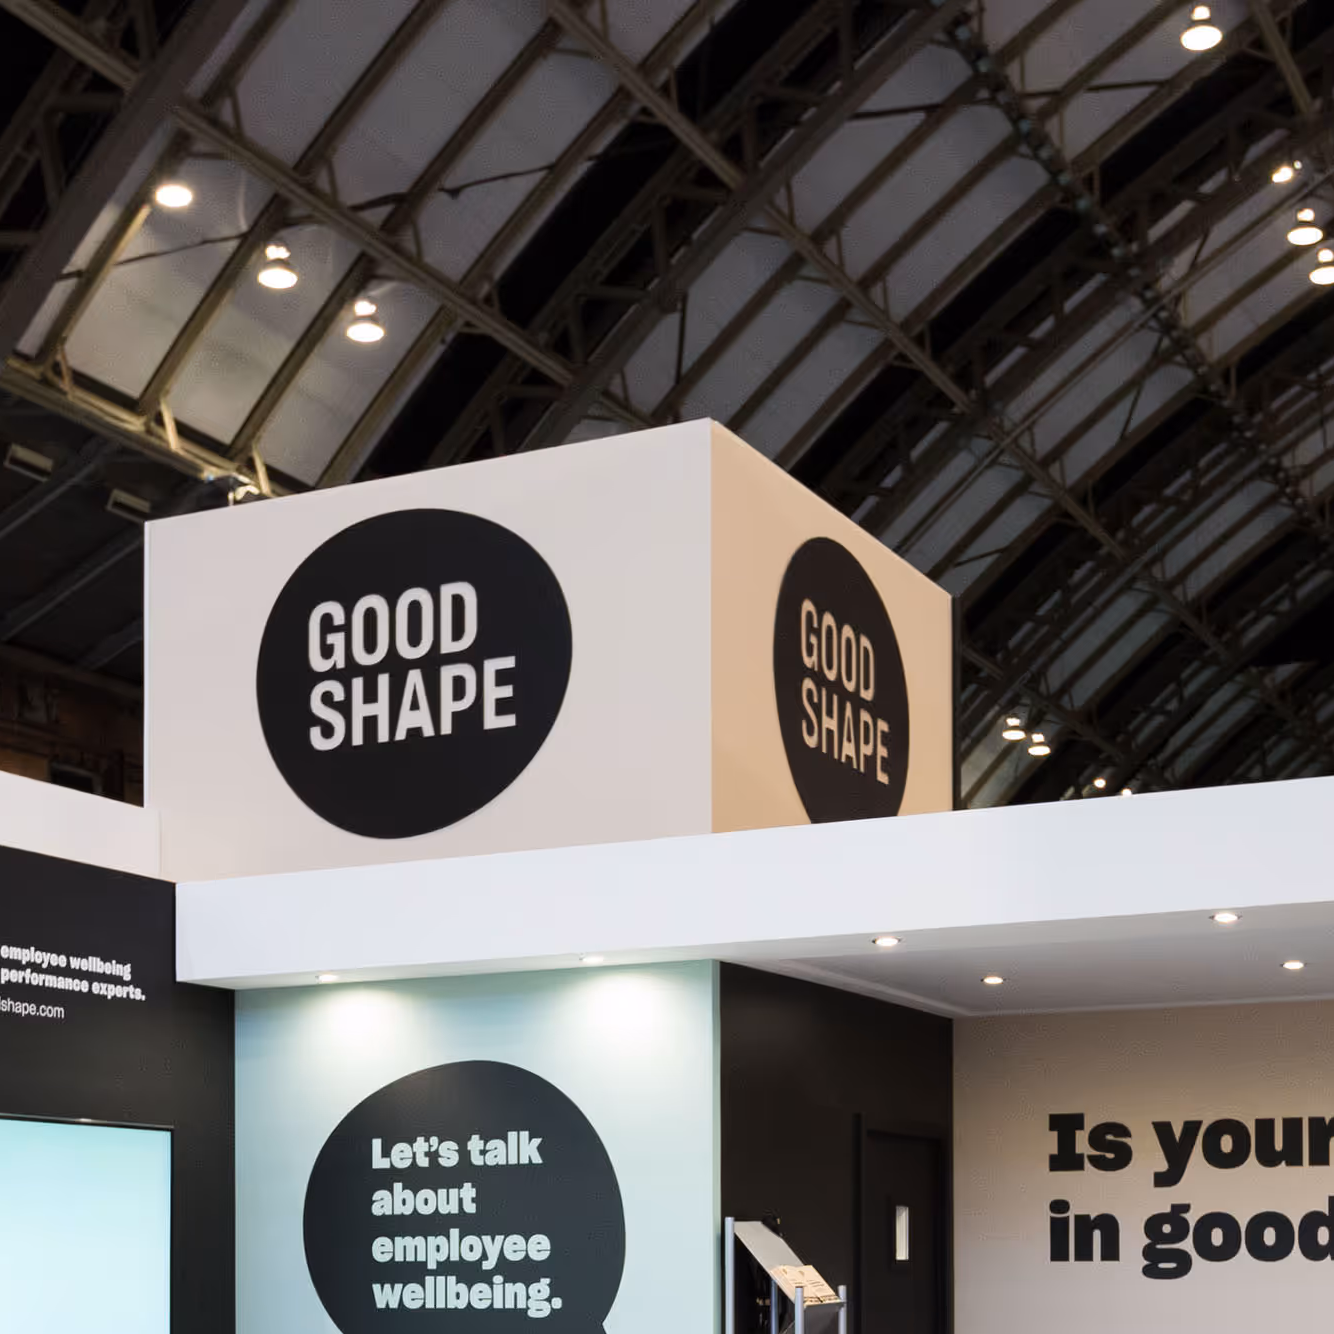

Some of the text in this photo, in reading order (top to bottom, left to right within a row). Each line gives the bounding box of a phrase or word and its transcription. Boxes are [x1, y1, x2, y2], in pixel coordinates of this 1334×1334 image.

[308, 580, 478, 673] GOOD
[800, 597, 875, 702] GOOD
[308, 655, 517, 752] SHAPE
[801, 676, 890, 786] SHAPE
[0, 945, 67, 969] employee
[69, 956, 132, 981] wellbeing
[0, 968, 90, 993] performance
[92, 981, 147, 1002] experts.
[467, 1130, 544, 1167] talk
[1048, 1112, 1133, 1173] Is
[371, 1182, 477, 1217] about
[371, 1228, 552, 1271] employee
[1049, 1198, 1121, 1263] in
[371, 1275, 563, 1319] wellbeing.
